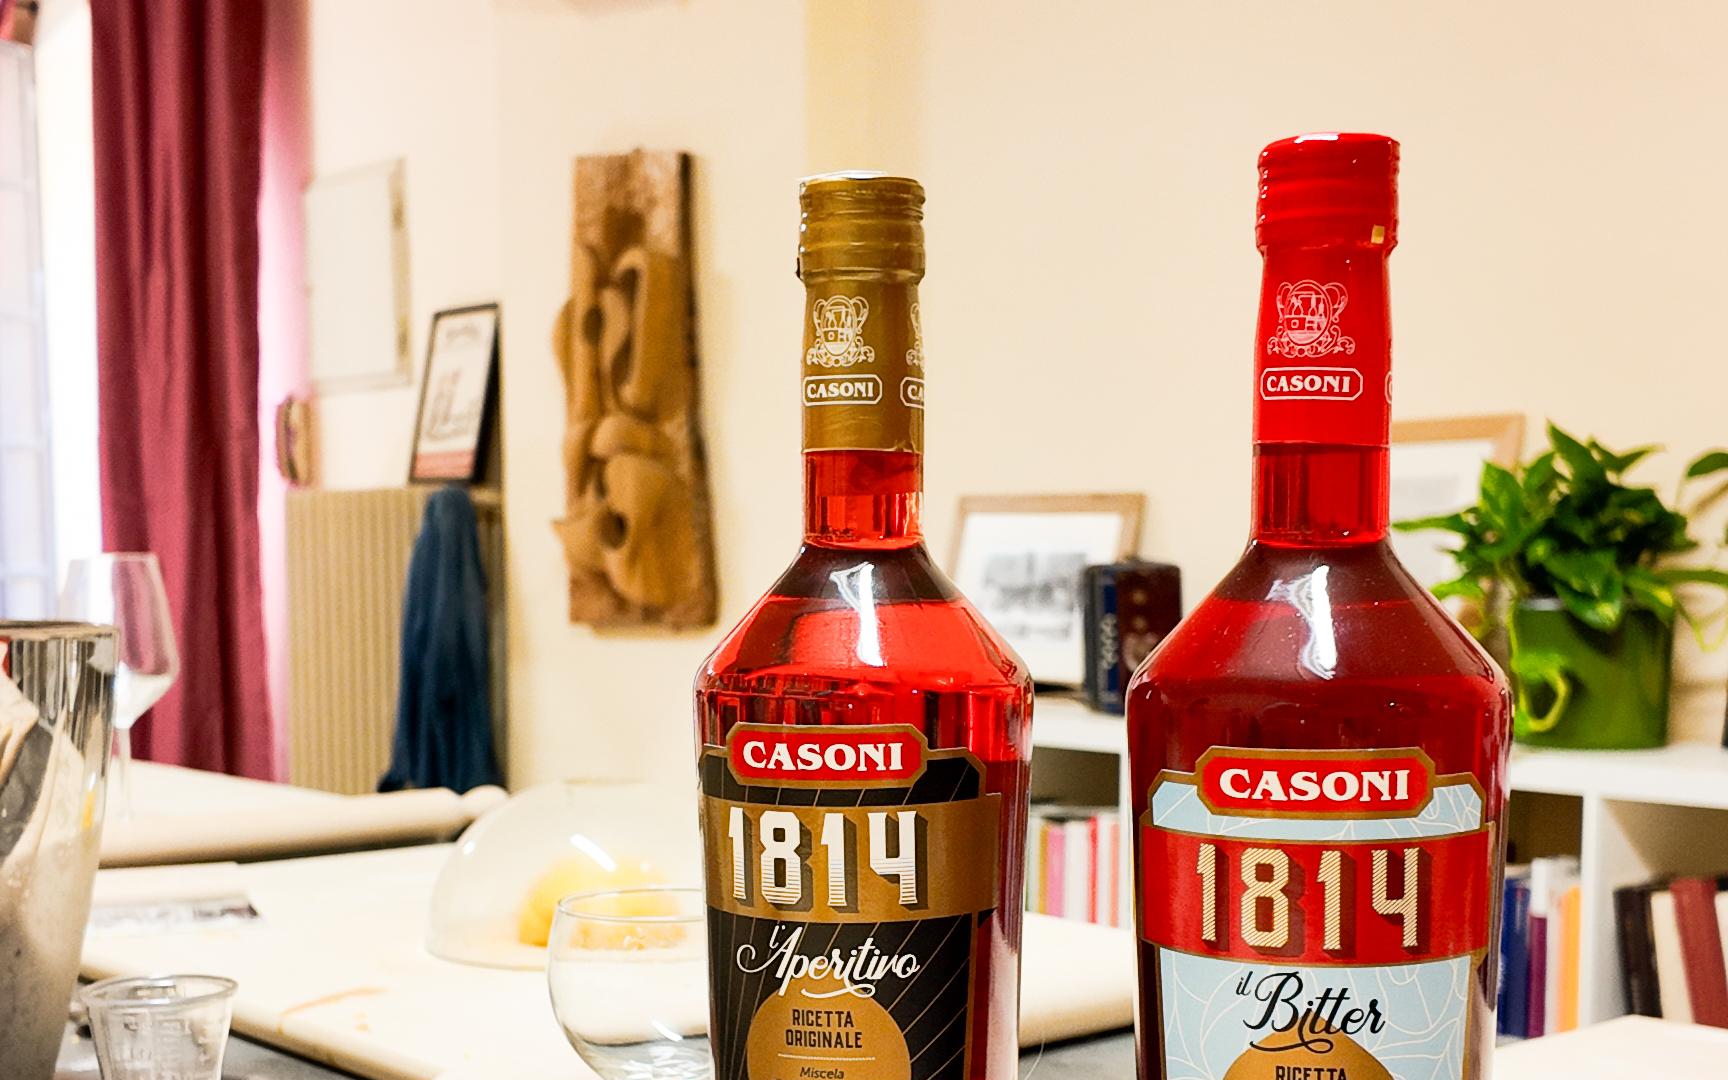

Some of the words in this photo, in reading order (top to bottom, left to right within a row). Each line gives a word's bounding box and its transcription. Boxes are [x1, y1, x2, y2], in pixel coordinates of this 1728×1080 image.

[807, 382, 874, 398] CASONI
[1267, 375, 1351, 392] CASONI
[743, 741, 904, 771] CASONI
[1219, 768, 1410, 802] CASONI
[728, 807, 922, 907] 1814
[1197, 842, 1422, 950] 1814
[1235, 971, 1253, 997] il
[792, 1009, 854, 1028] RICETTA
[1243, 972, 1385, 1053] Bitter
[785, 1029, 863, 1048] ORIGINALE
[799, 1066, 845, 1080] Miscela
